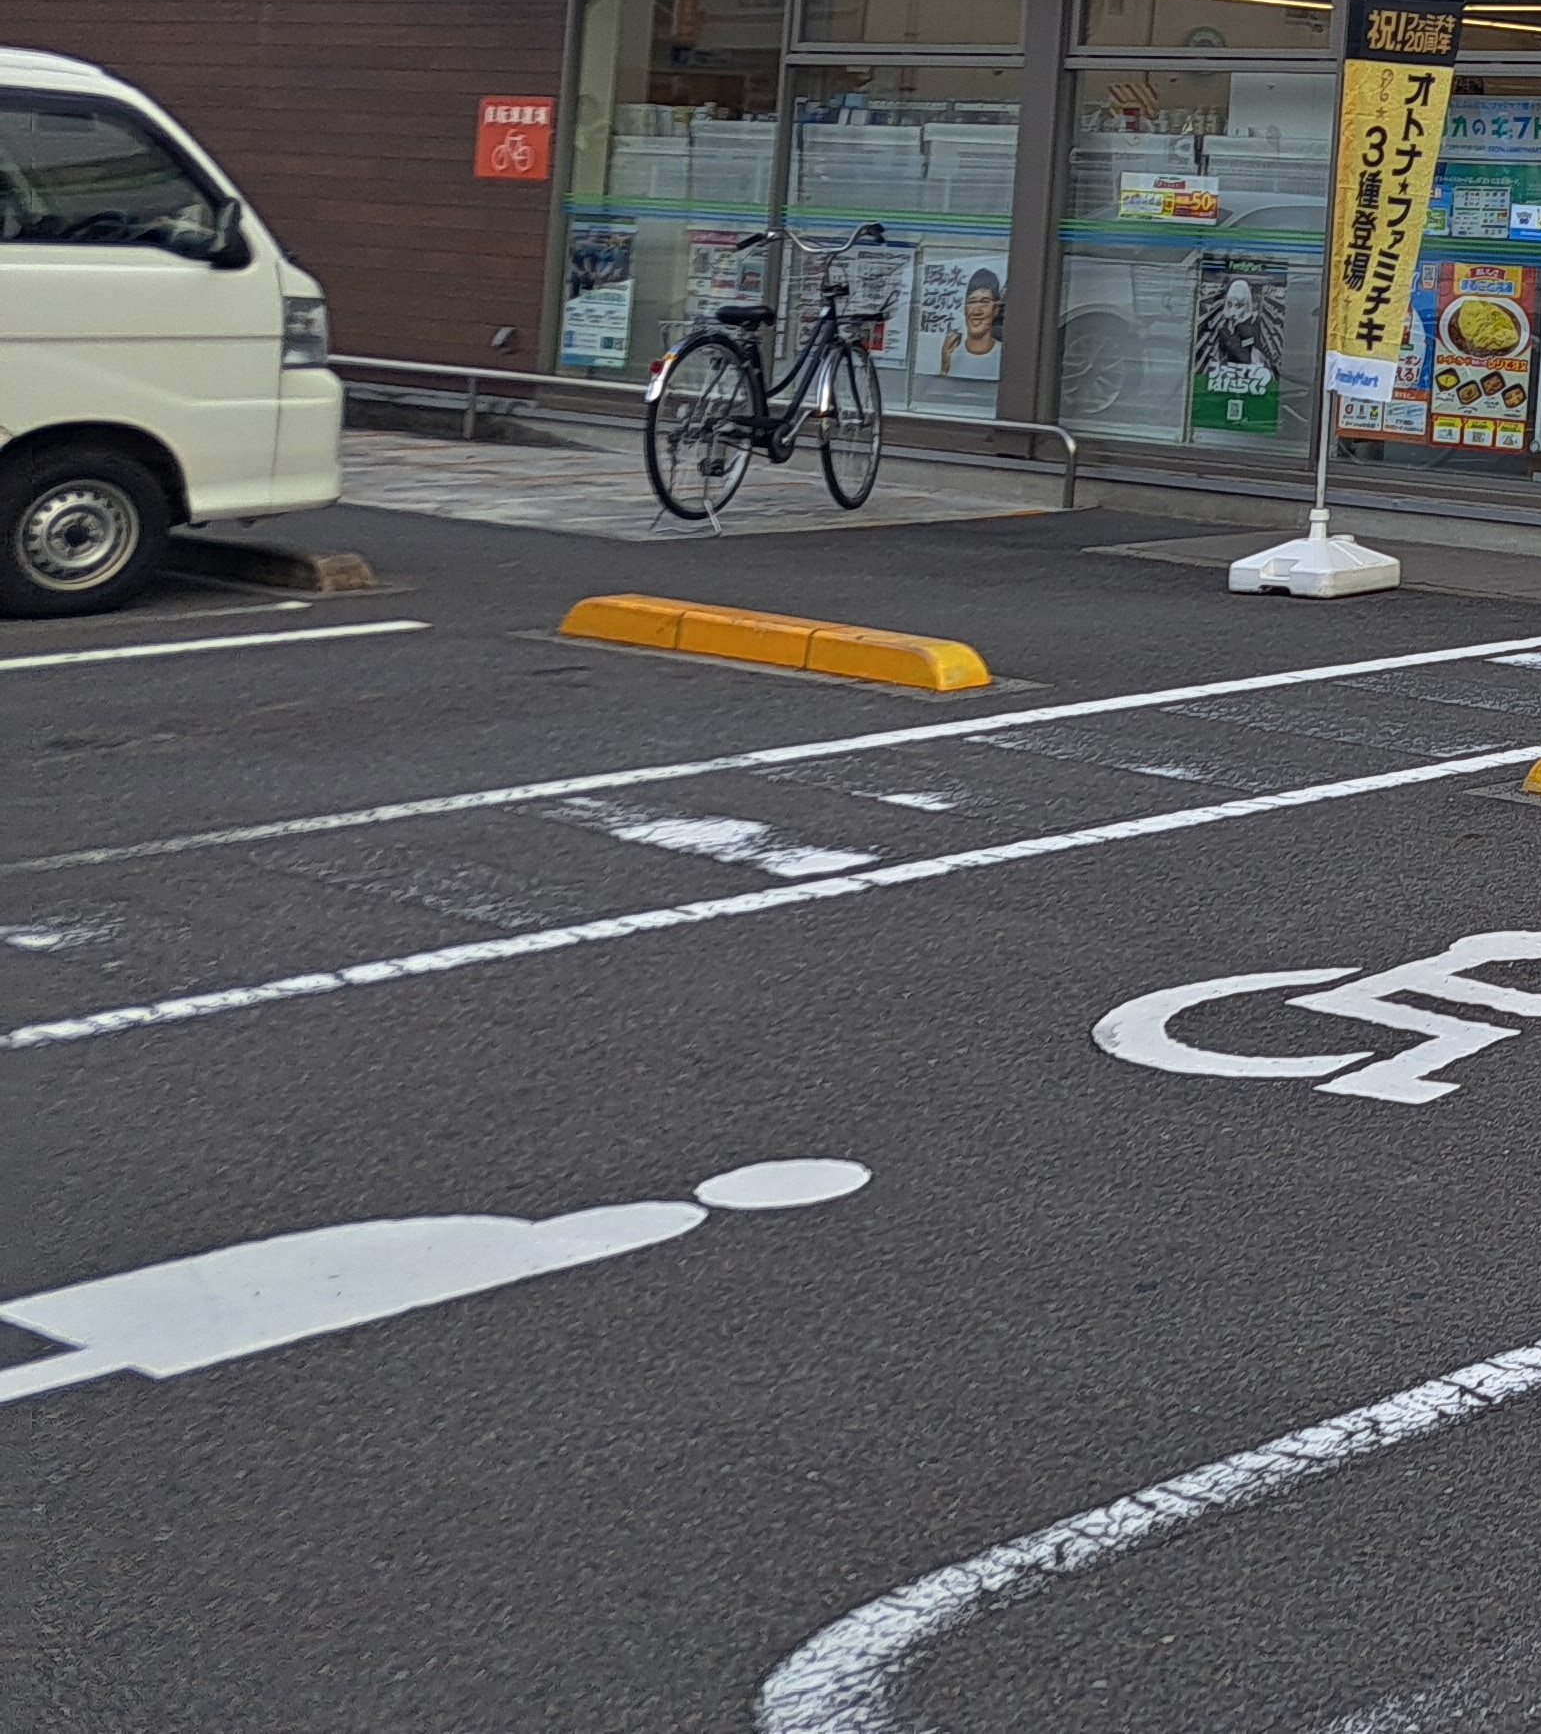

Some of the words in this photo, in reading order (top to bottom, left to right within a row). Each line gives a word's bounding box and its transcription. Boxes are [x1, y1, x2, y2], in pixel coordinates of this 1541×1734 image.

[1407, 12, 1458, 33] ファミチキ
[1404, 31, 1454, 55] 20周年
[1343, 125, 1388, 293] 3種登場
